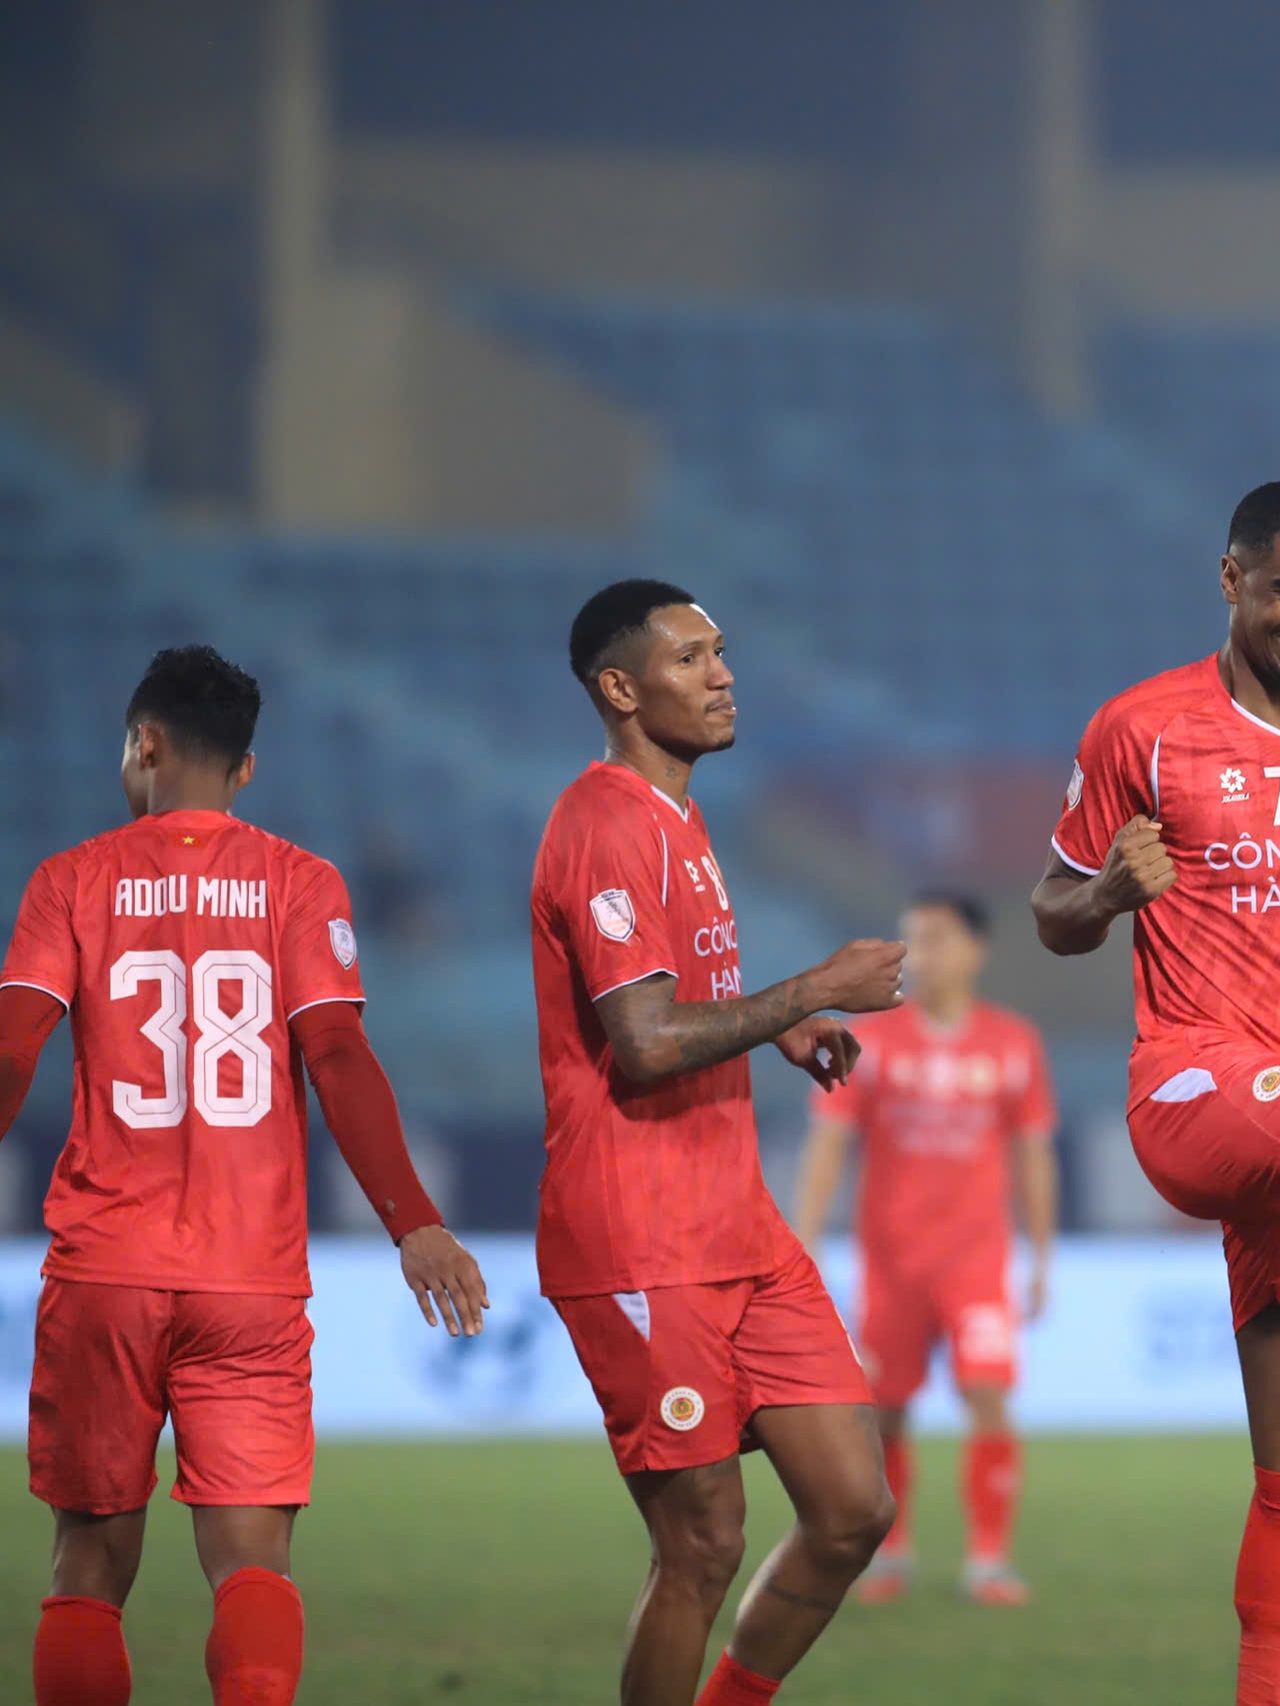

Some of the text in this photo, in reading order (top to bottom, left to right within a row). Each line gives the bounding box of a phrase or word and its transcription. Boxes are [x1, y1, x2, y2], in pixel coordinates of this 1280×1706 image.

[114, 875, 267, 918] ADOU MINH
[110, 949, 273, 1130] 38
